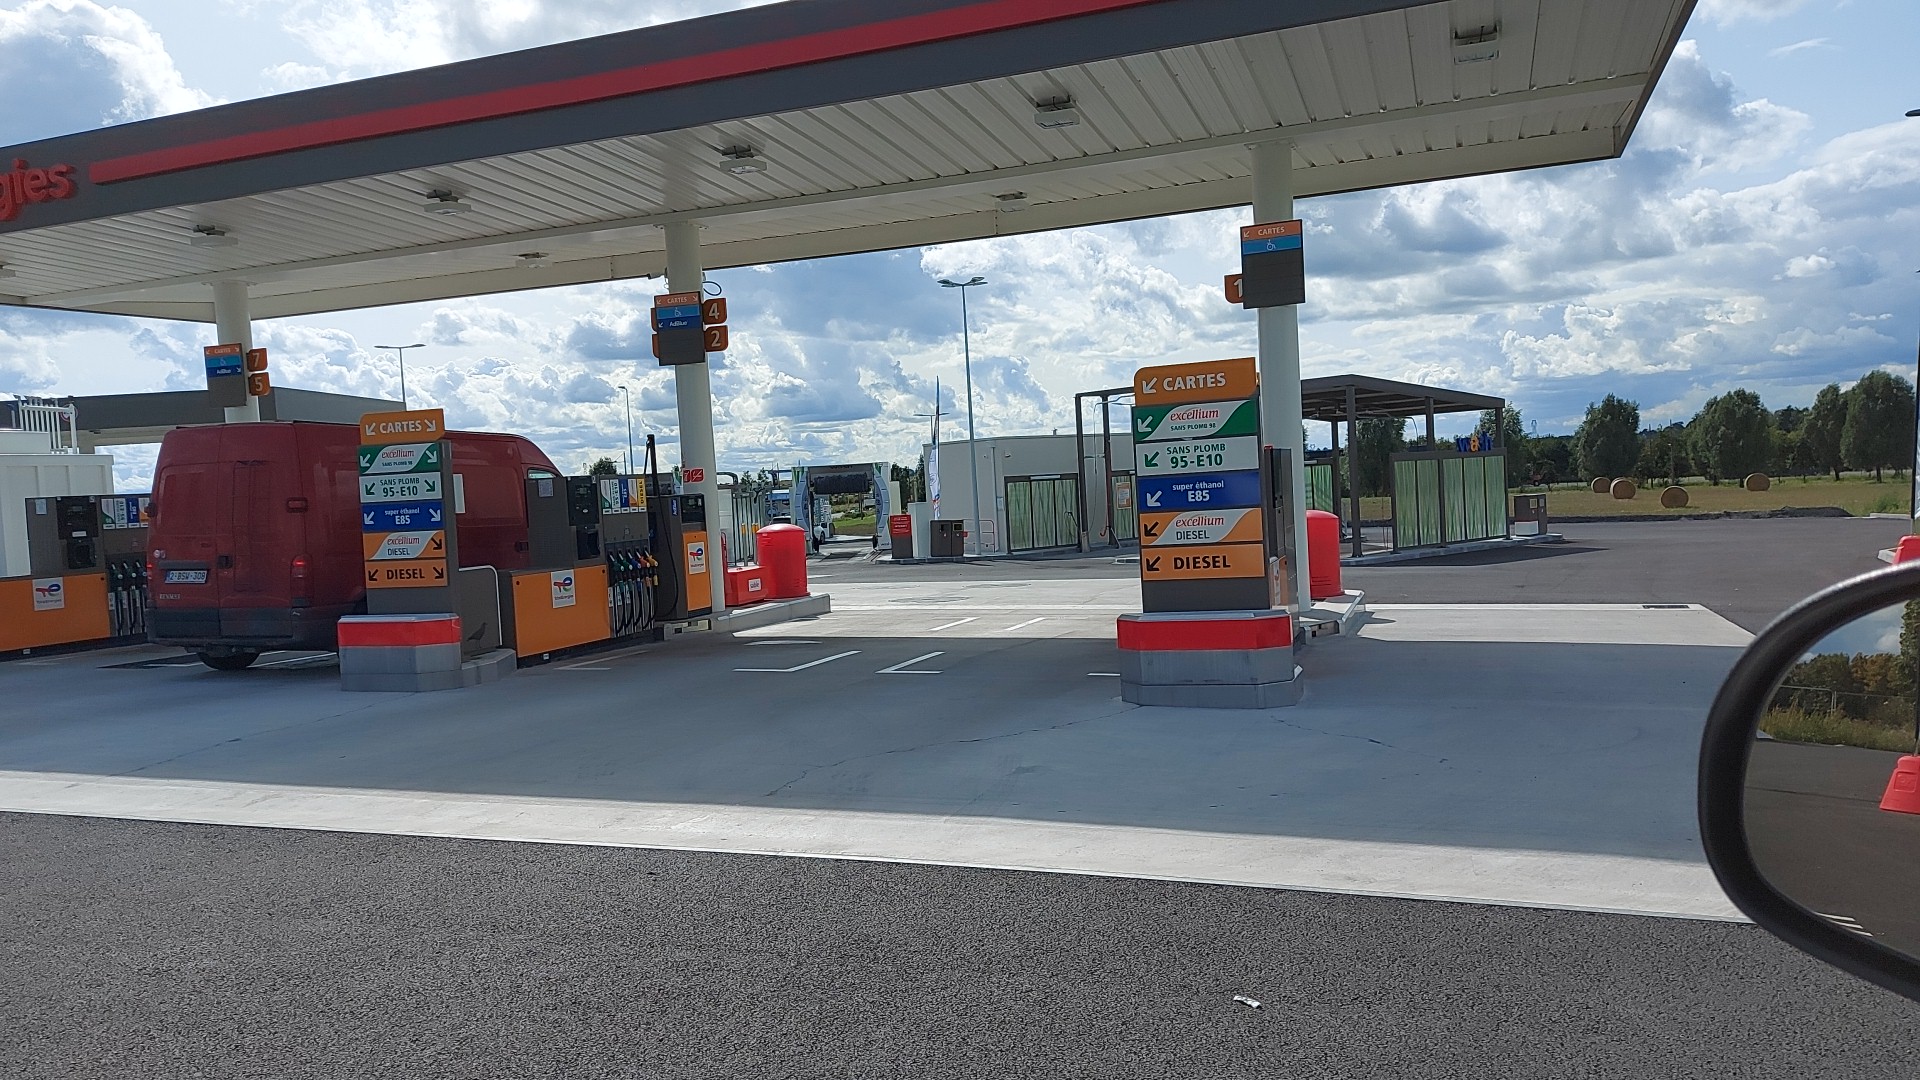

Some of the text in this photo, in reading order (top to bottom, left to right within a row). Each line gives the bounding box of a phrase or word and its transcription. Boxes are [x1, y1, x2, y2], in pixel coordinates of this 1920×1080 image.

[1258, 226, 1285, 236] CARTES
[667, 296, 688, 304] CARTES
[708, 302, 720, 320] 4
[711, 330, 721, 347] 2
[252, 352, 260, 368] 7
[254, 377, 263, 392] 5
[1163, 372, 1226, 391] CARTES
[1170, 408, 1219, 421] excellium
[379, 420, 422, 434] CARTES
[381, 448, 414, 459] excellium
[1166, 443, 1226, 455] SANS PLOMB
[1170, 453, 1223, 469] 95-E10
[398, 477, 420, 485] PLOMB
[1172, 480, 1224, 491] super éthanol
[382, 486, 418, 497] 95-E10
[1187, 490, 1210, 502] E85
[395, 515, 411, 525] E85
[1175, 515, 1224, 528] excellium
[387, 535, 420, 546] excellium
[1176, 530, 1210, 541] DIESEL
[387, 547, 410, 556] DIESEL
[1173, 555, 1231, 570] DIESEL
[386, 568, 425, 580] DIESEL
